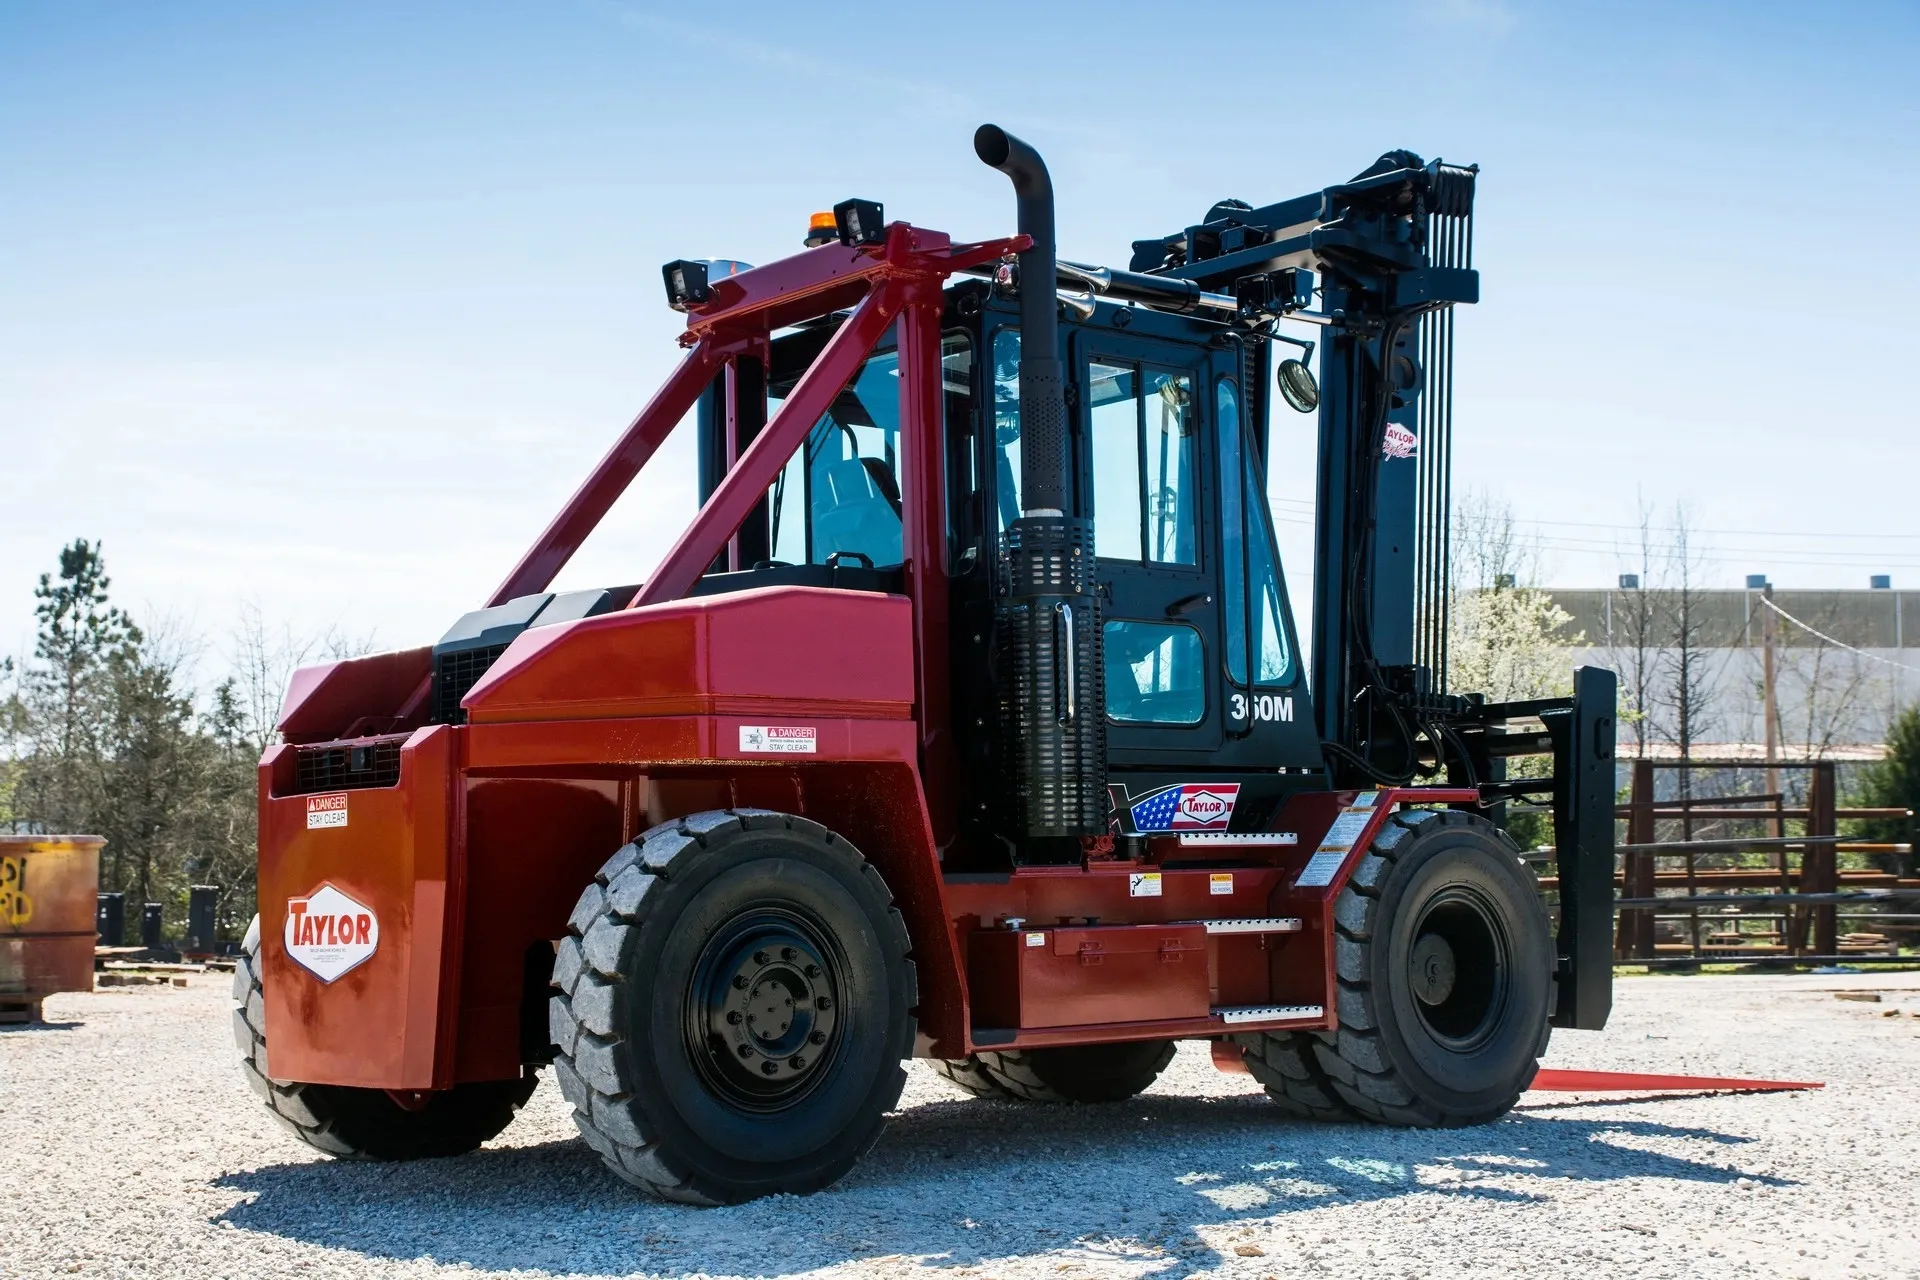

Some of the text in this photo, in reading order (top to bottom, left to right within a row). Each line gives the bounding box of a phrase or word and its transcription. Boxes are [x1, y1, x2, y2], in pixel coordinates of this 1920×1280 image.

[778, 728, 812, 738] DANGER
[315, 796, 346, 811] DANGER
[1187, 797, 1221, 812] TAYLOR
[309, 812, 346, 826] STAY CLEAR
[290, 901, 371, 946] TAYLOR
